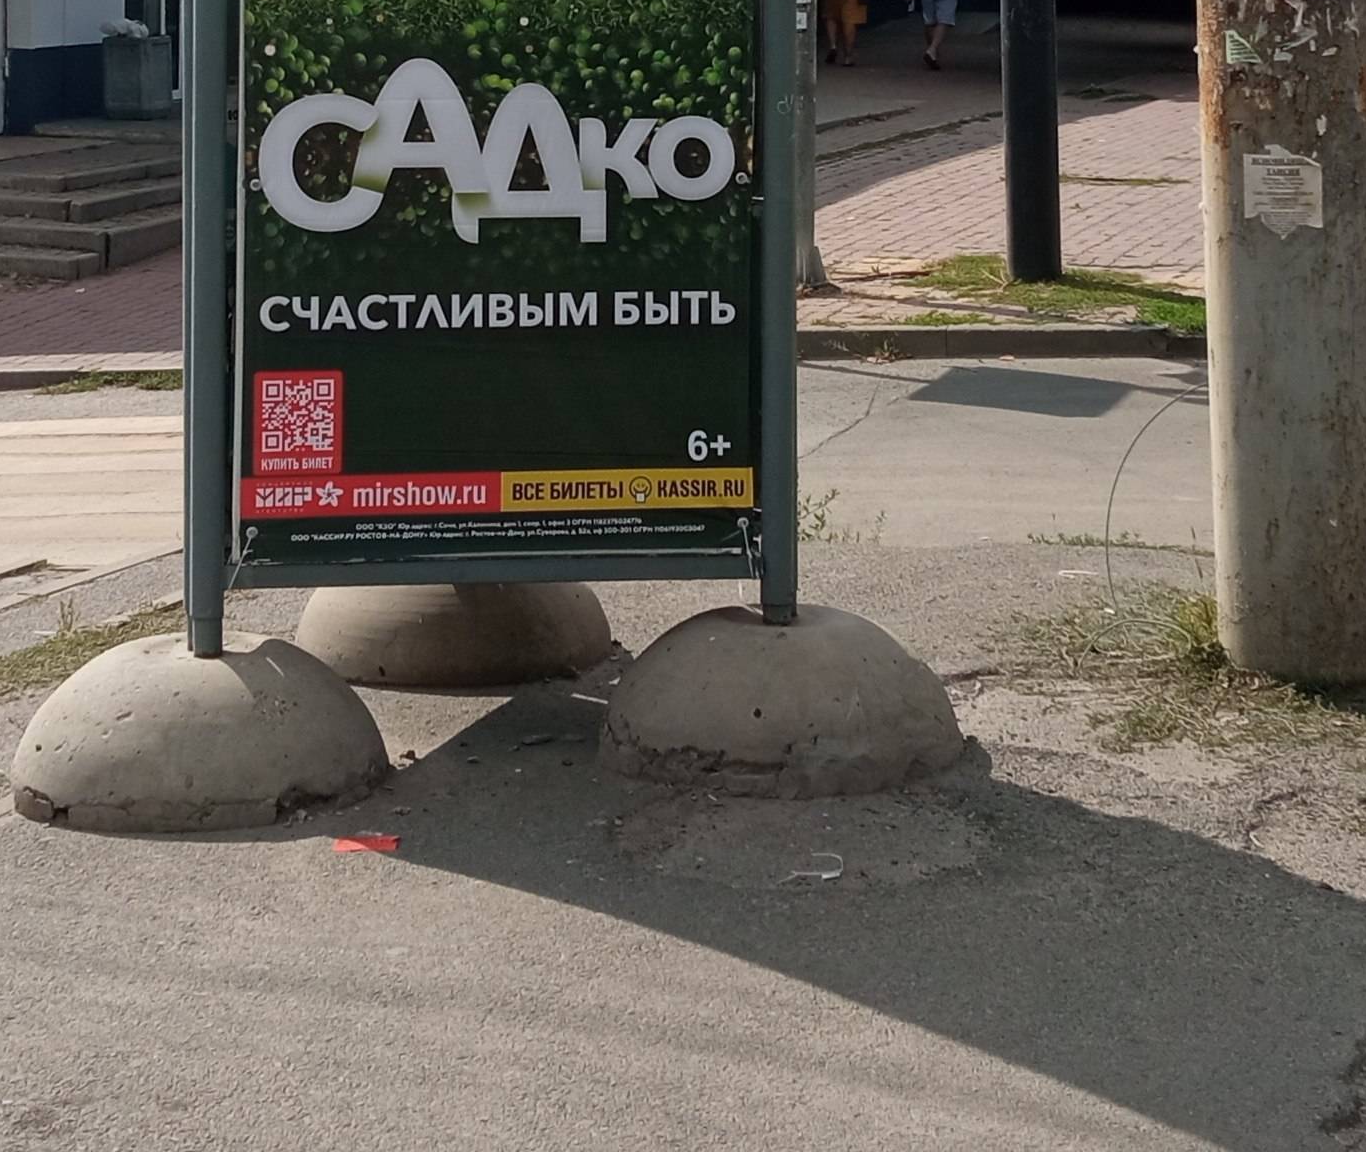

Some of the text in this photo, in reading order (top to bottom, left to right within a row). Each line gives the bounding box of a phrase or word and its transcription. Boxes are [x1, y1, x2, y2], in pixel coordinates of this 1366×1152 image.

[258, 289, 737, 332] СЧАСТЛИВЫМ БЫТЬ
[687, 429, 732, 462] 6+
[261, 457, 333, 471] КУПИТЬ БИЛЕТ
[353, 482, 487, 507] mirshow.ru
[512, 482, 544, 501] ВСЕ
[550, 481, 623, 501] БИЛЕТЫ
[657, 479, 745, 499] KASSIR.RU
